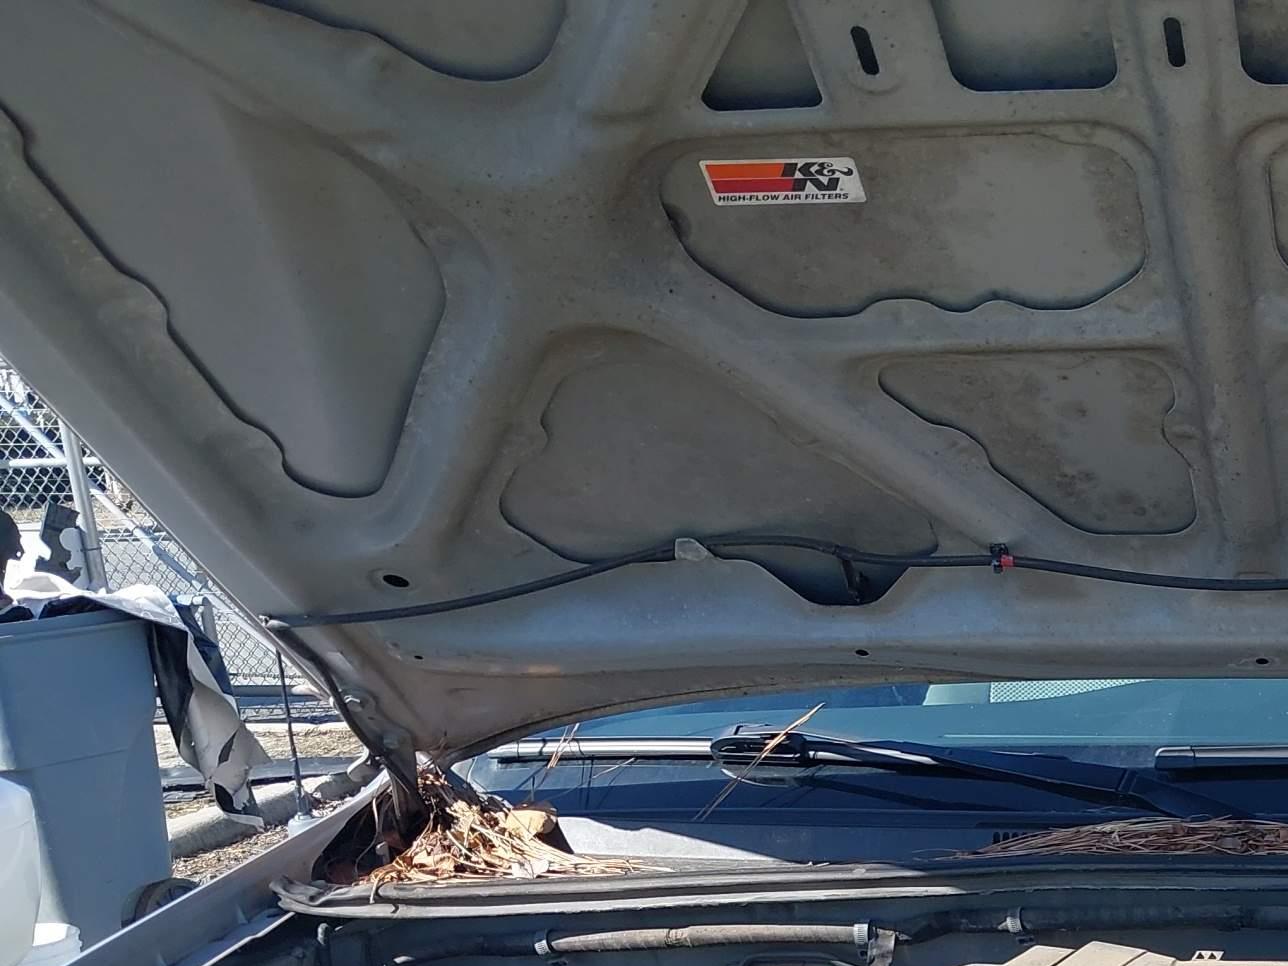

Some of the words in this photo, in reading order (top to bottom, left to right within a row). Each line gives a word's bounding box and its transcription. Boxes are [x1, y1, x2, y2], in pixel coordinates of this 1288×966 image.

[718, 194, 780, 203] HIGH-FLOW
[782, 193, 802, 202] AIR
[804, 192, 849, 201] FILTERS
